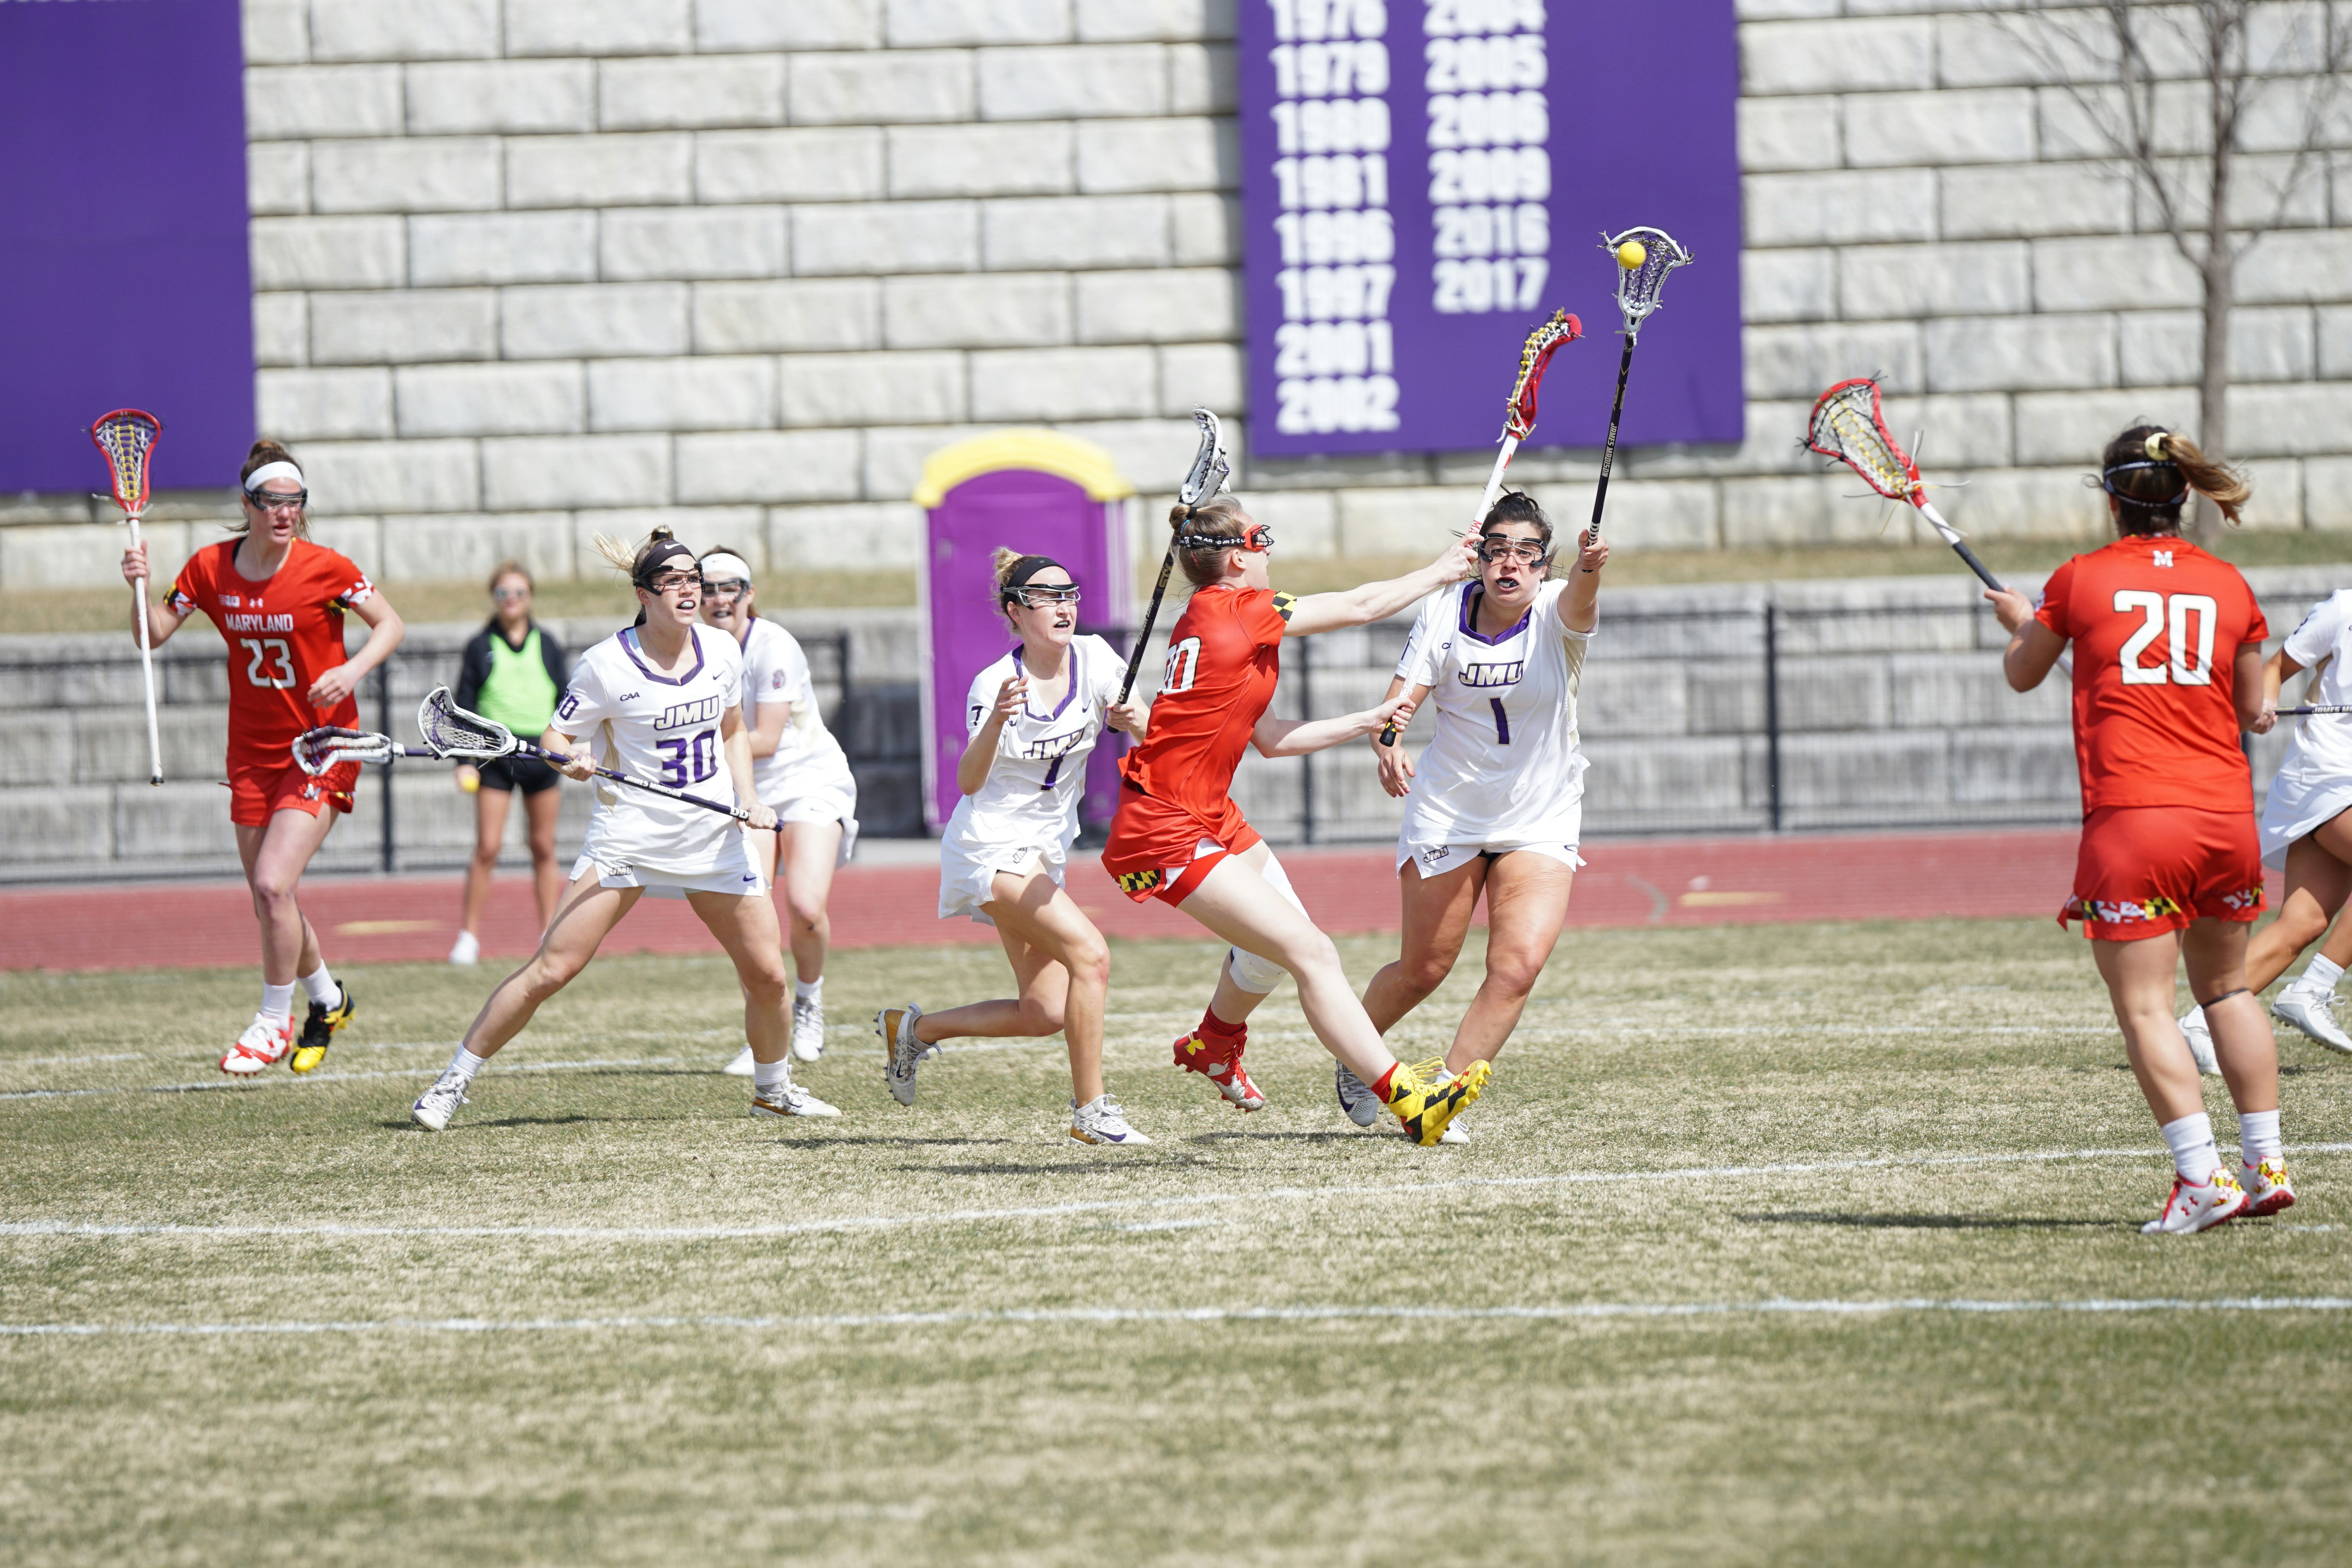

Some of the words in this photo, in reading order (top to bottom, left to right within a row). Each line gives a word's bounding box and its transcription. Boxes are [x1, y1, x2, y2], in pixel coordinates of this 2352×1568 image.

[1269, 40, 1390, 98] 1979
[1425, 34, 1548, 93] 2005
[1426, 89, 1549, 148] 2006
[1272, 152, 1389, 211] 1981
[1428, 145, 1551, 204] 2009
[1432, 201, 1550, 258] 2016
[1275, 263, 1397, 321] 1997
[1432, 257, 1549, 312] 2017
[1275, 319, 1393, 377] 2001
[1277, 374, 1401, 434] 2002
[1608, 422, 1617, 446] JAMES
[1602, 446, 1613, 477] MADISON
[225, 613, 294, 632] MARYLAND
[2113, 590, 2217, 686] 20
[240, 637, 296, 689] 23
[1458, 660, 1524, 688] JMU
[620, 692, 640, 701] CAA
[653, 695, 719, 730] JMU
[971, 705, 984, 726] 7
[1488, 697, 1511, 746] 1
[655, 730, 719, 789] 30
[1022, 728, 1085, 760] JMU
[624, 775, 649, 787] JAMES
[649, 782, 682, 797] MADISON
[609, 866, 633, 876] JMU
[1423, 845, 1449, 863] JMU
